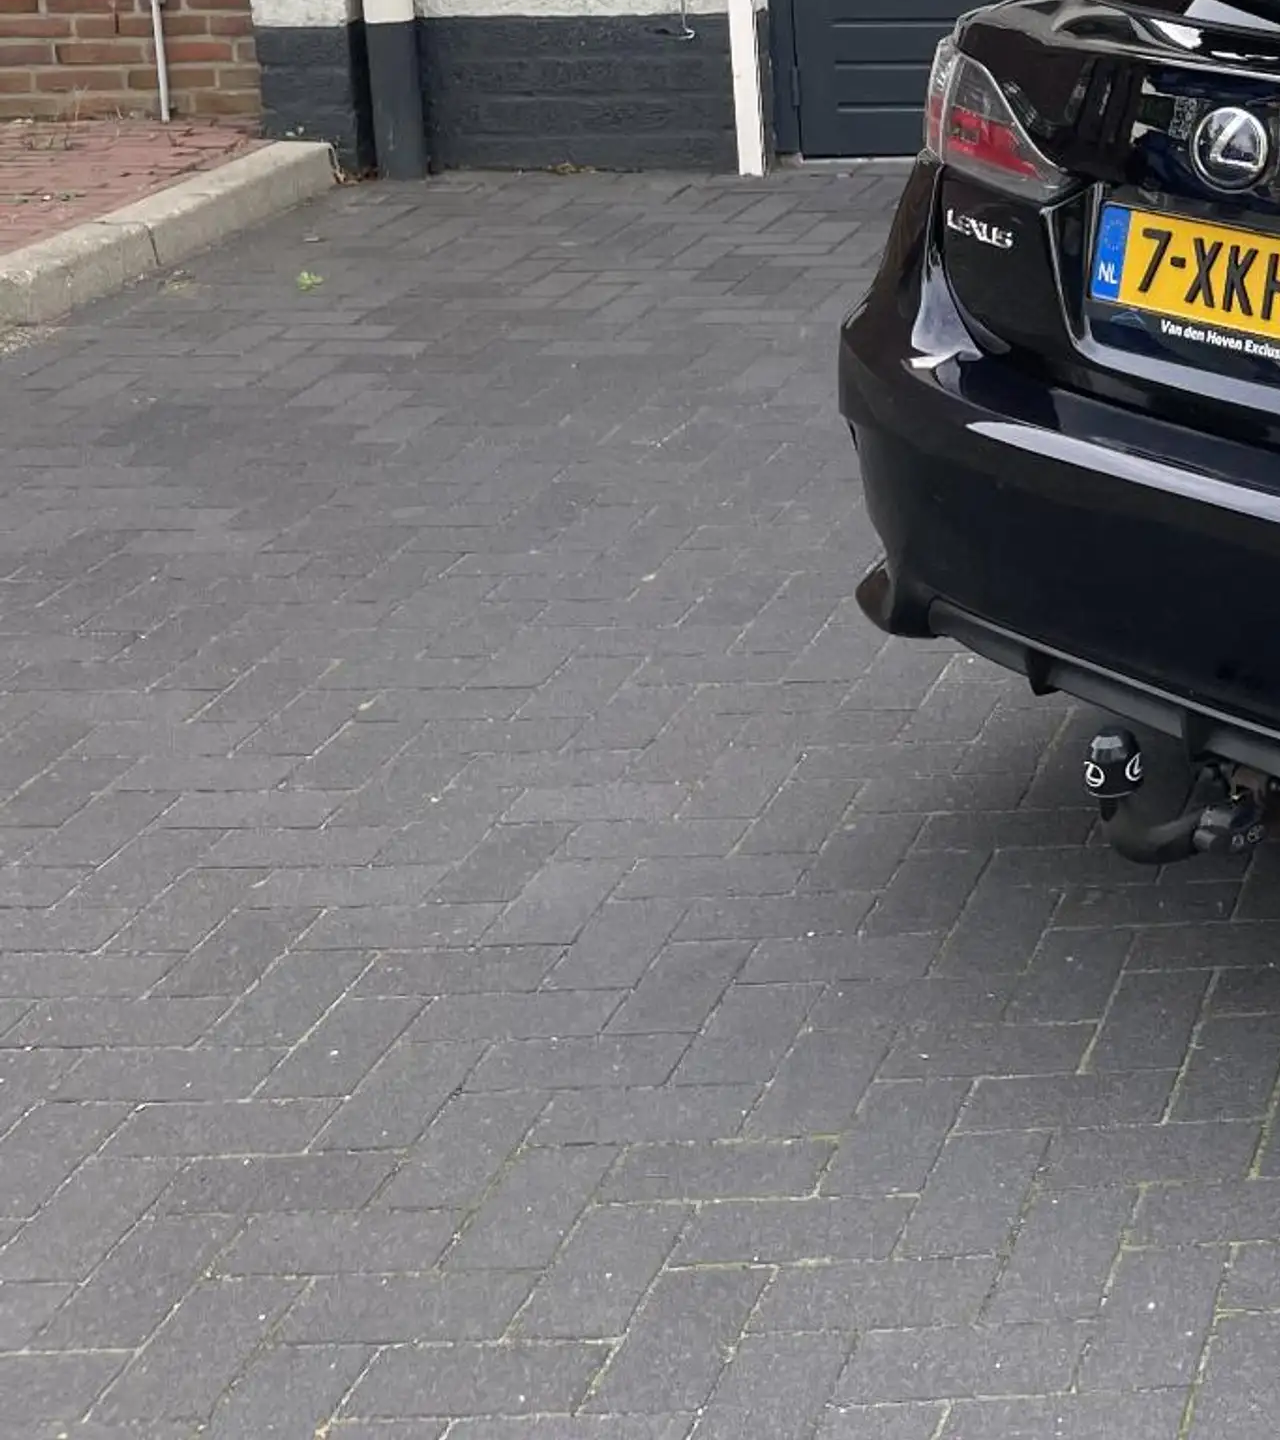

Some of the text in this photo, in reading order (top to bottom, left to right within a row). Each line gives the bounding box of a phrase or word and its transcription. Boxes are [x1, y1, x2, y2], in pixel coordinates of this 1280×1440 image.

[946, 207, 1015, 249] LEXUS
[1097, 261, 1118, 286] NL
[1160, 318, 1183, 338] Van
[1183, 325, 1206, 344] den
[1206, 329, 1243, 352] Hoven
